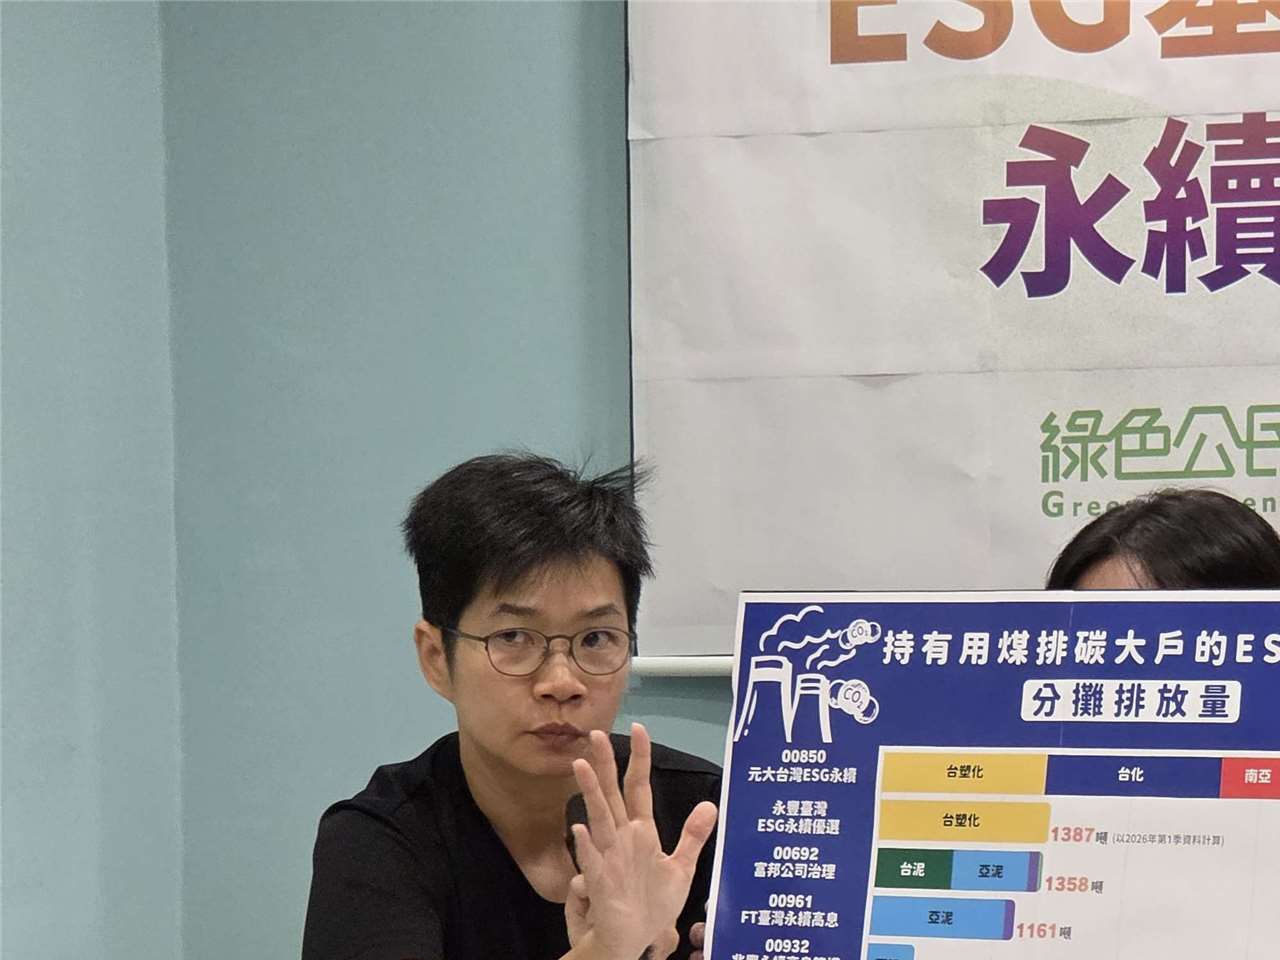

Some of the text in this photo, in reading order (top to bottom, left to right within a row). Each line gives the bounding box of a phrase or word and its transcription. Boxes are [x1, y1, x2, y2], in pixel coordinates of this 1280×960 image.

[1041, 490, 1120, 518] Gree
[1032, 682, 1231, 719] 分攤排放量
[782, 750, 826, 763] 00850
[748, 767, 857, 783] 元大台灣ESG永續
[947, 764, 983, 779] 台塑化
[1118, 766, 1144, 782] 台化
[1244, 768, 1272, 784] 南亞
[772, 800, 828, 816] 永豐臺灣
[757, 819, 840, 834] ESG永續優選
[942, 813, 980, 828] 台塑化
[1051, 827, 1095, 842] 1387
[773, 847, 819, 860] 00692
[754, 862, 836, 879] 富邦公司治理
[900, 862, 925, 877] 台泥
[978, 864, 1003, 878] 亞泥
[1045, 876, 1089, 892] 1358
[769, 894, 812, 908] 00961
[740, 910, 839, 928] FT臺灣永續高息
[928, 910, 953, 925] 亞泥
[1016, 923, 1058, 938] 1161
[765, 939, 810, 953] 00932
